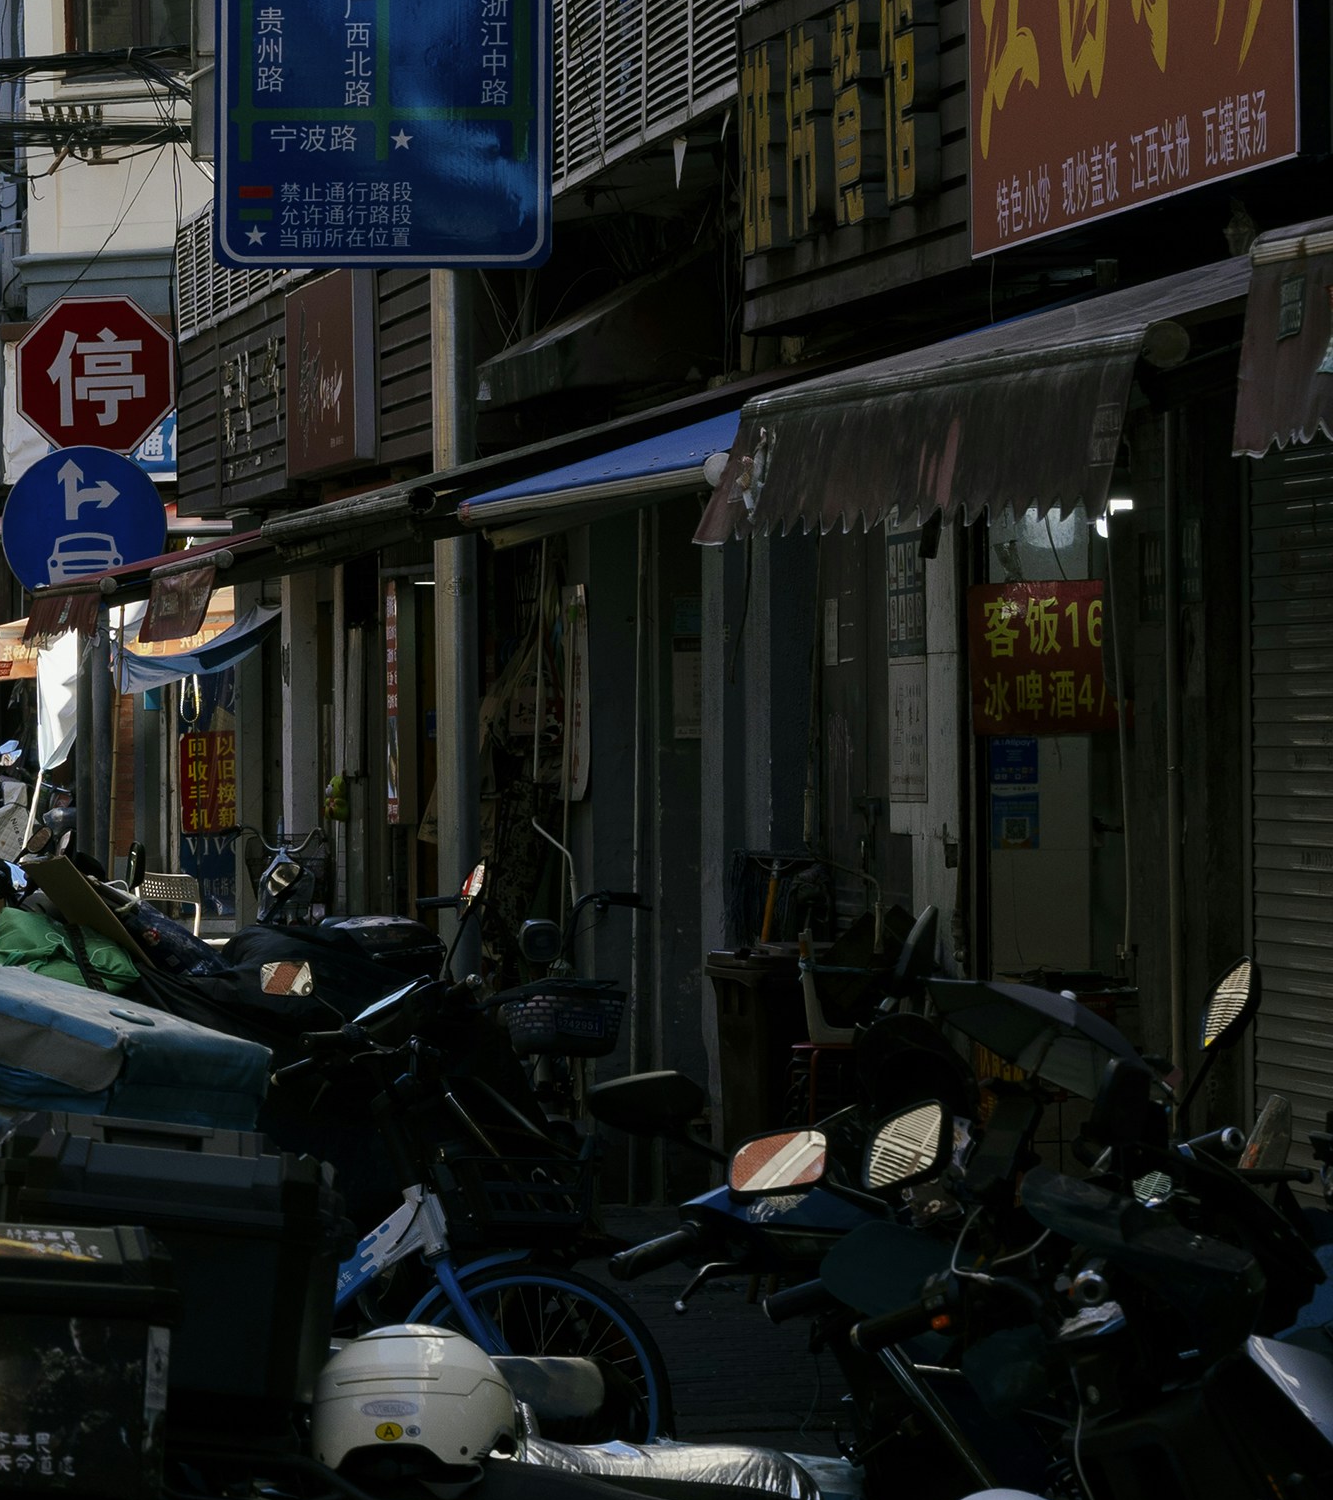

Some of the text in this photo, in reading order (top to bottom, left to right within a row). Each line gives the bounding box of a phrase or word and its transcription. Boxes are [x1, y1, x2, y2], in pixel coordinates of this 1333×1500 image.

[256, 5, 285, 93] 贵州路
[270, 124, 358, 153] 宁波路
[996, 88, 1268, 239] 特色小炒 现炒盖饭 江西米粉 瓦罐煨汤
[280, 181, 413, 204] 禁止通行路段
[280, 204, 413, 227] 允许通行路段
[279, 226, 413, 249] 当前所在位置
[46, 327, 147, 427] 停
[188, 738, 211, 830] 回收手机
[215, 736, 236, 828] 以旧换新
